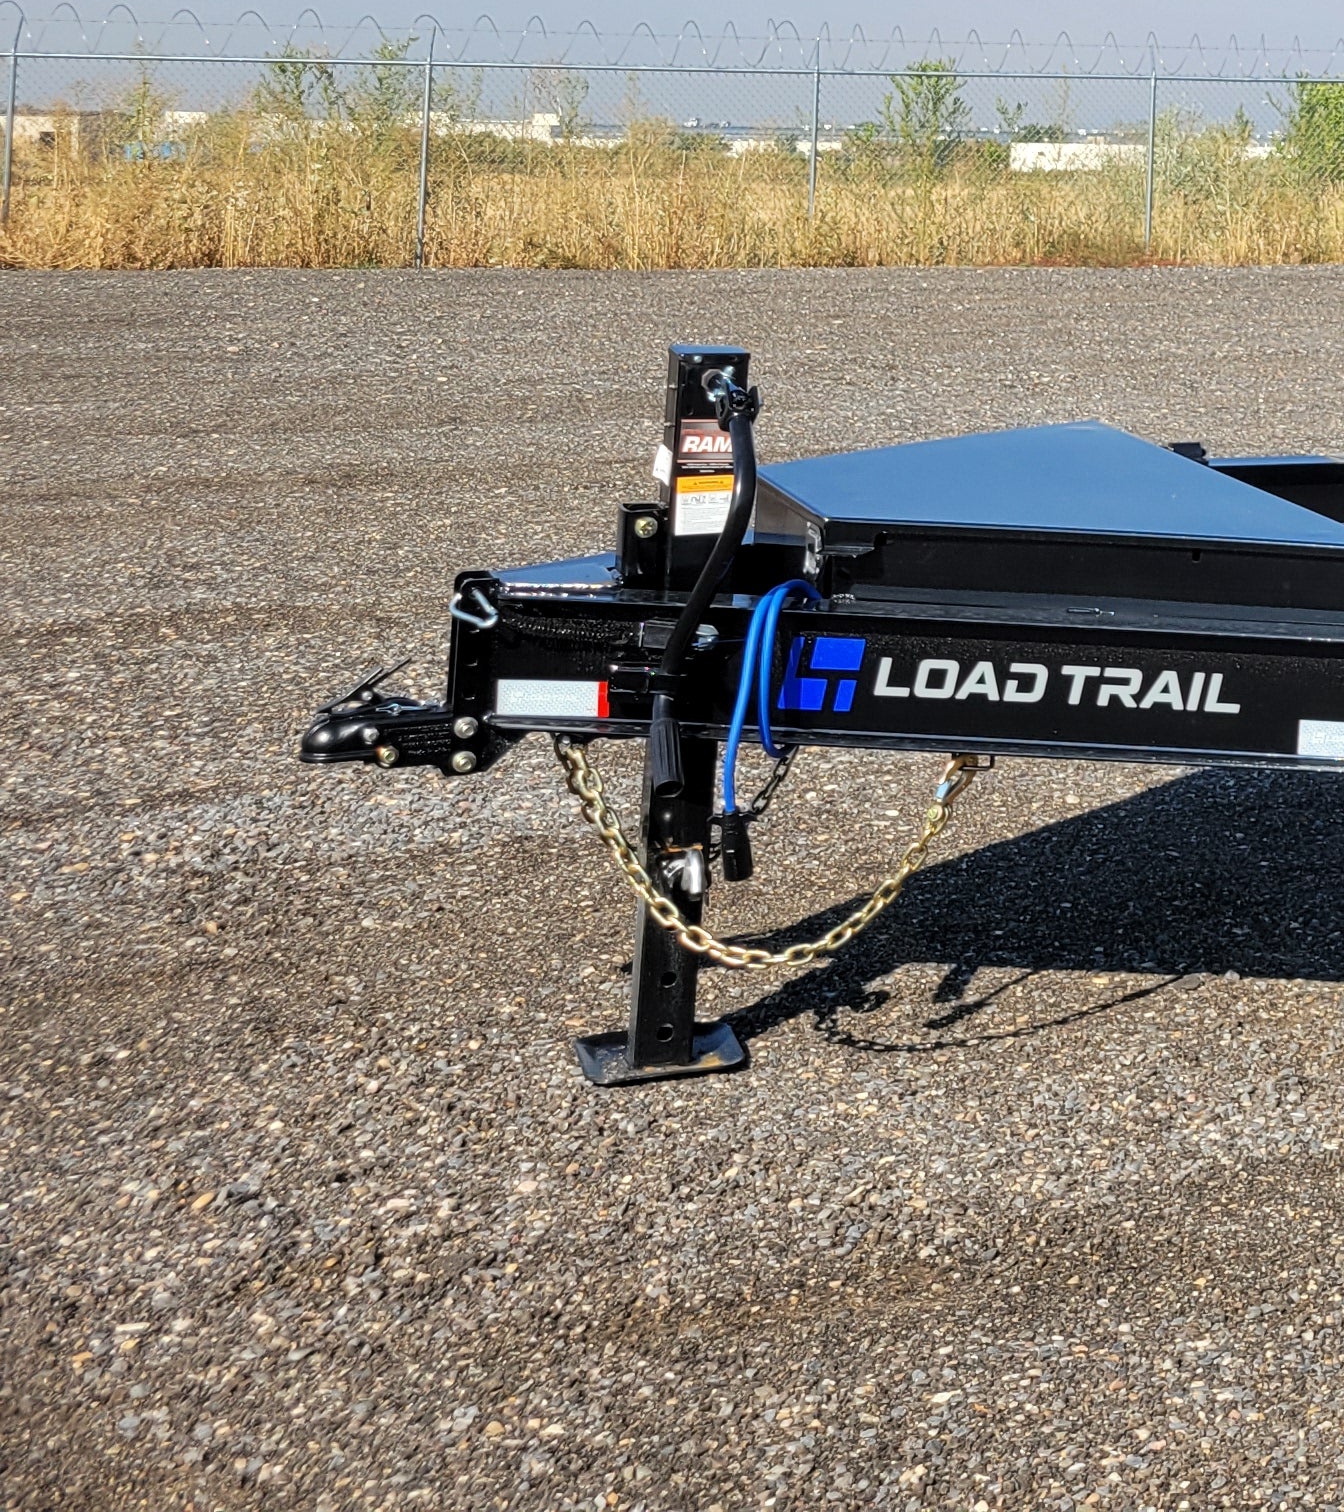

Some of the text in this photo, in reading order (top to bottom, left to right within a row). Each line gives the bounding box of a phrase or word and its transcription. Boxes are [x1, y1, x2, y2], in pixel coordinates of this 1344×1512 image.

[682, 436, 732, 453] RAM
[873, 656, 1241, 714] LOAD TRAIL
